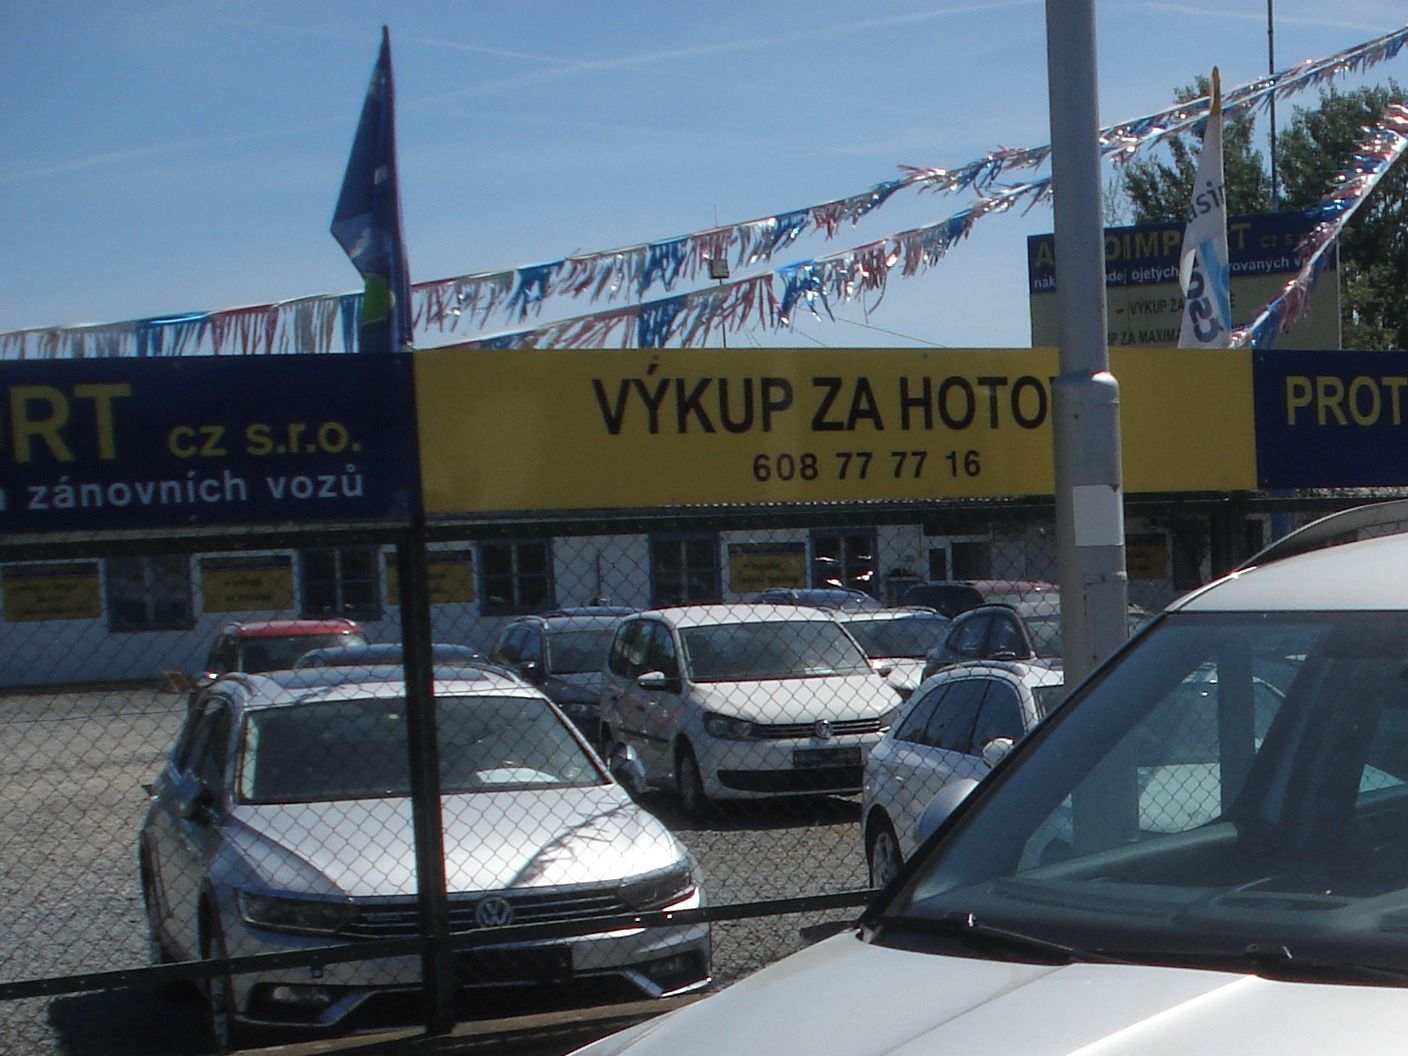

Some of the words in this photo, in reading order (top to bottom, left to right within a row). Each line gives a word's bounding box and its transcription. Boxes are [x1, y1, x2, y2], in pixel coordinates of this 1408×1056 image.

[1034, 223, 1252, 268] AOIMPT
[591, 363, 793, 434] VÝKUP
[811, 376, 885, 432] ZA
[900, 375, 1056, 431] HOTO
[4, 383, 131, 464] RT
[167, 424, 228, 459] cz
[245, 420, 362, 455] s.r.o.
[27, 470, 248, 511] zánovních
[266, 462, 364, 500] vozů
[752, 452, 819, 482] 608
[835, 451, 873, 480] 77
[890, 451, 928, 479] 77
[945, 449, 982, 478] 16
